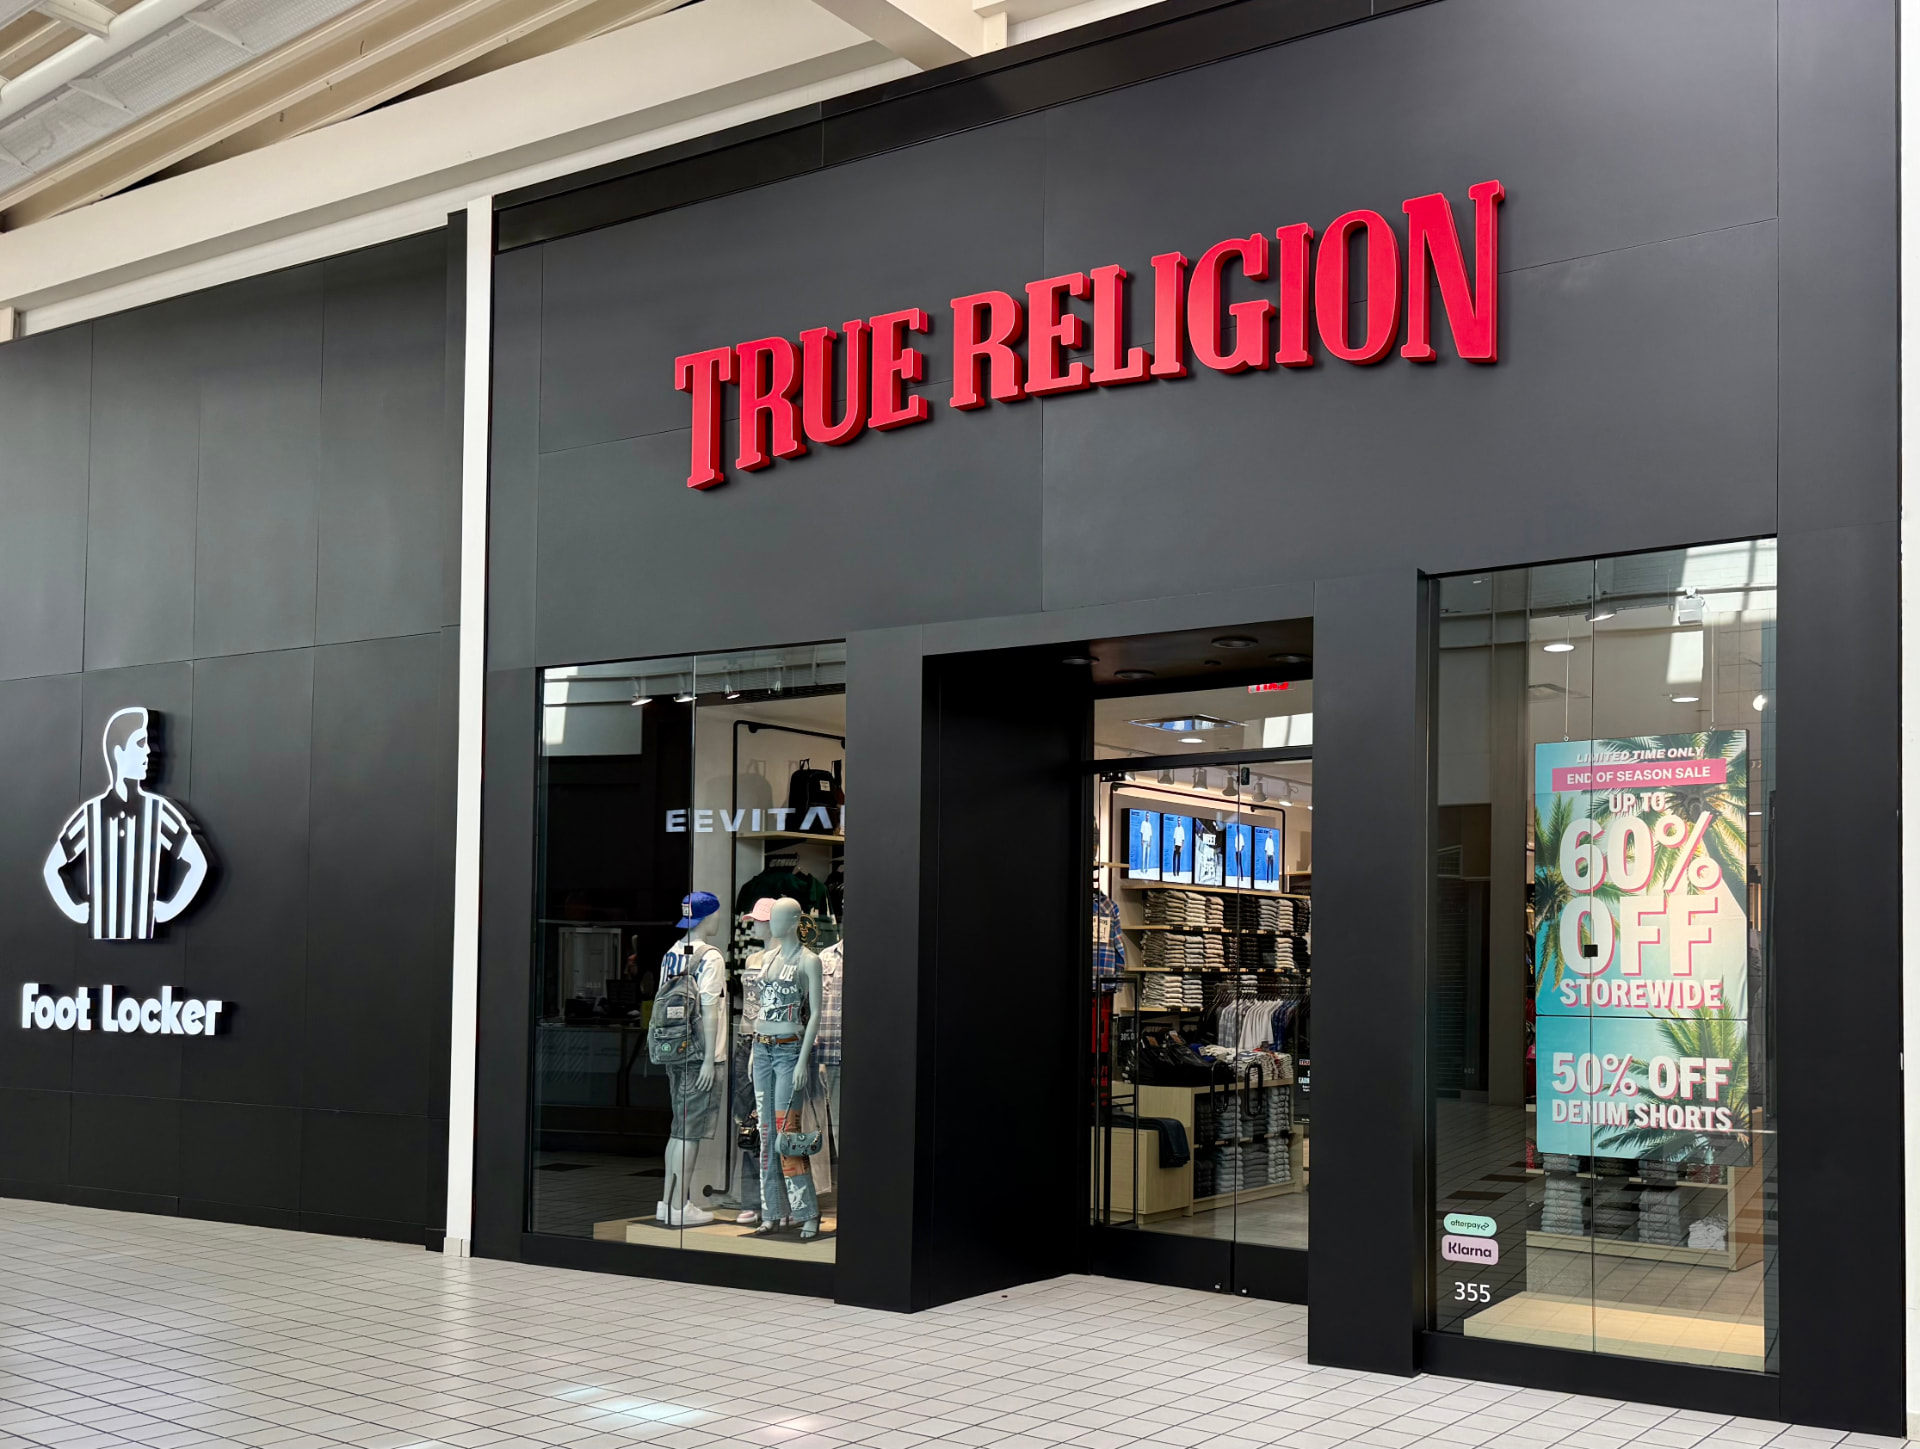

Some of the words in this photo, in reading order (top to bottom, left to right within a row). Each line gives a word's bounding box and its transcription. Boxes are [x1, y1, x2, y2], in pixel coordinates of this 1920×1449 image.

[674, 307, 930, 491] TRUE
[949, 179, 1505, 411] RELIGION
[1576, 750, 1631, 764] LIMITED
[1633, 748, 1665, 762] TIME
[1667, 746, 1705, 759] ONLY
[1566, 771, 1594, 785] END
[1596, 770, 1614, 783] OF
[1616, 768, 1672, 782] SEASON
[1675, 765, 1711, 779] SALE
[1608, 793, 1637, 813] UP
[1640, 791, 1667, 813] TO
[1559, 810, 1723, 894] 60%
[1559, 895, 1719, 977] OFF
[22, 983, 92, 1031] Foot
[102, 984, 222, 1036] Locker
[1559, 978, 1725, 1010] STOREWIDE
[1551, 1051, 1638, 1097] 50%
[1648, 1055, 1733, 1101] OFF
[1551, 1099, 1629, 1127] DENIM
[1634, 1103, 1734, 1133] SHORTS
[1450, 1219, 1481, 1230] afterpay
[1448, 1241, 1492, 1258] Klarna
[1454, 1281, 1491, 1303] 355
